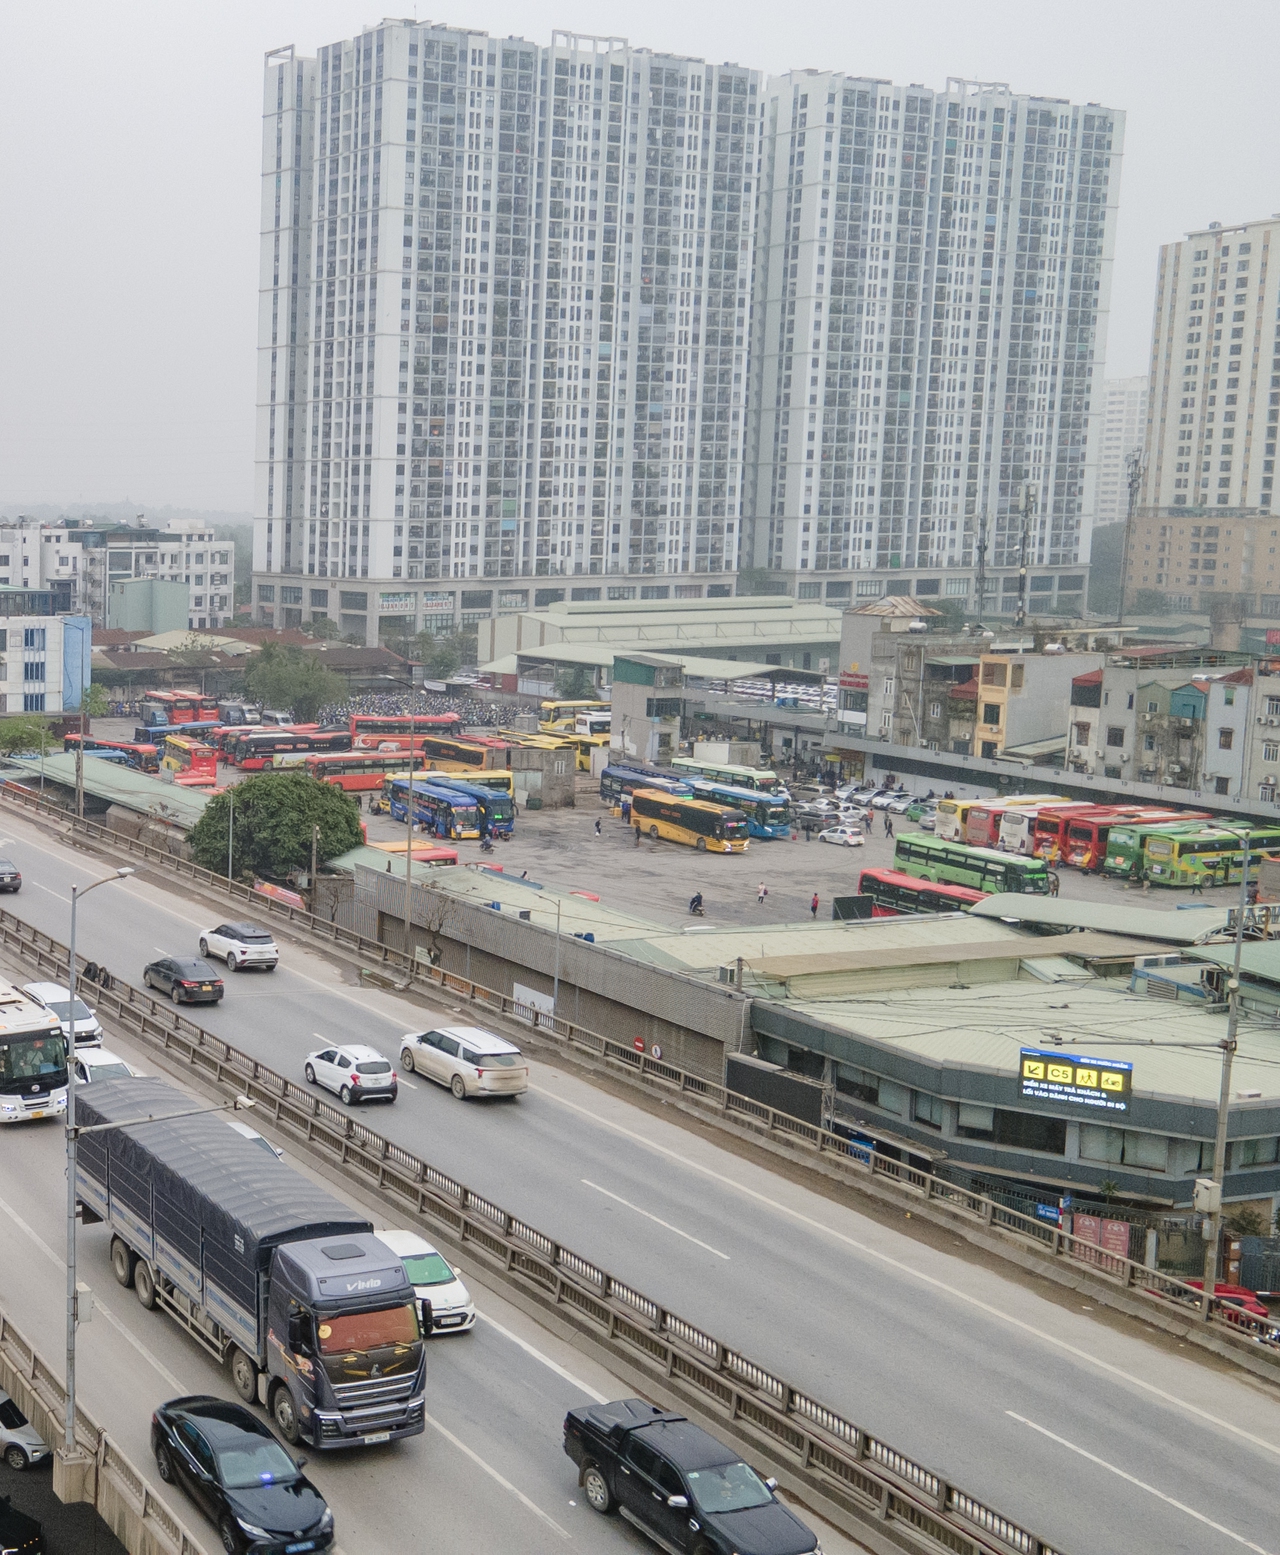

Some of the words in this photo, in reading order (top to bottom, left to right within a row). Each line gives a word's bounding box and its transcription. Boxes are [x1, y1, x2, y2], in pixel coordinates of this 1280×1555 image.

[1051, 1068, 1069, 1079] C5
[1077, 1088, 1100, 1097] KHÁCH
[1023, 1087, 1033, 1095] LỐI
[1034, 1089, 1048, 1097] VÀO
[1049, 1091, 1068, 1100] DÀNH
[1084, 1098, 1106, 1107] NGƯỜI
[1115, 1103, 1126, 1111] BỘ
